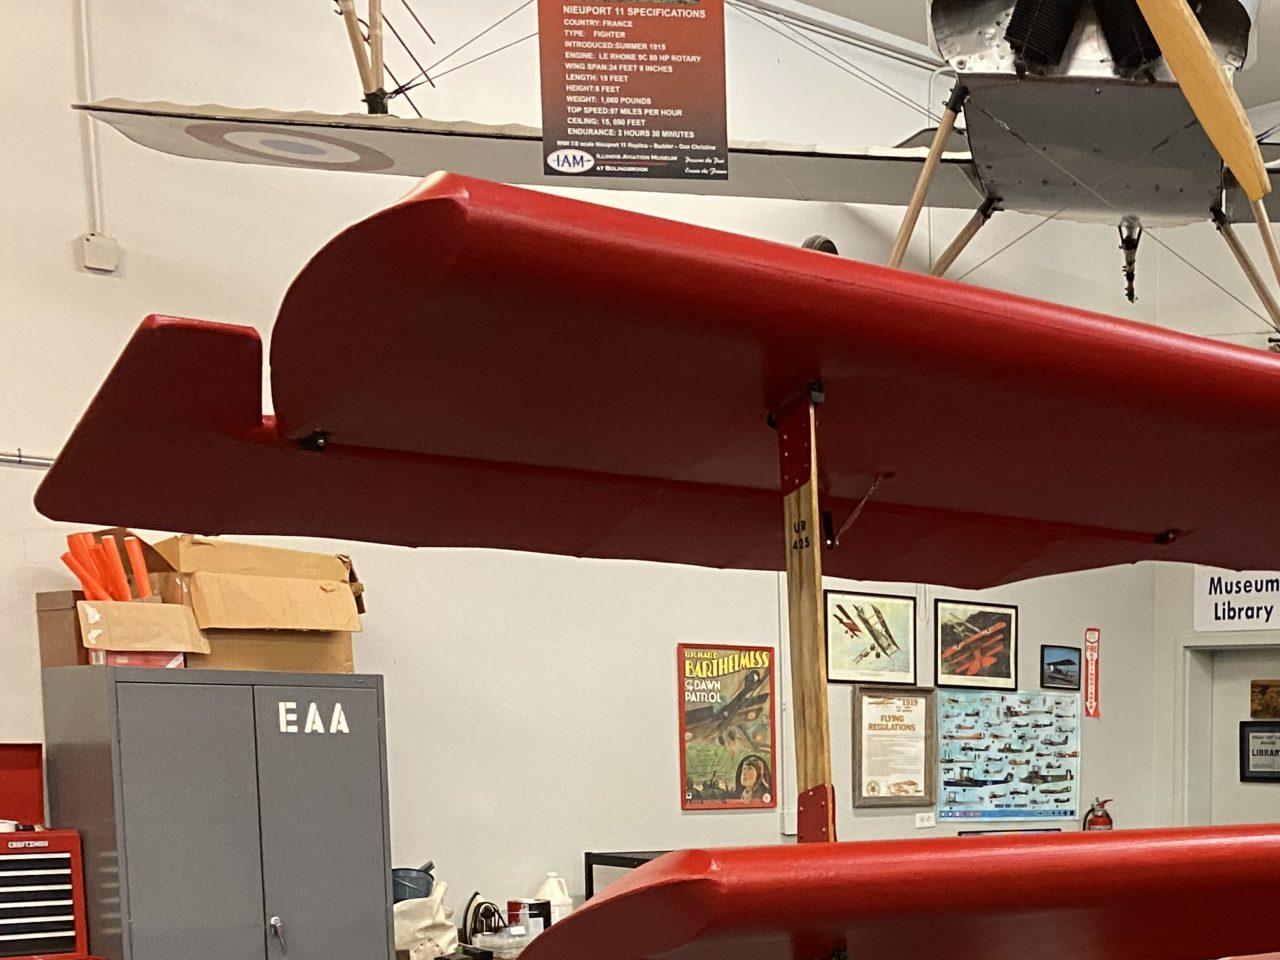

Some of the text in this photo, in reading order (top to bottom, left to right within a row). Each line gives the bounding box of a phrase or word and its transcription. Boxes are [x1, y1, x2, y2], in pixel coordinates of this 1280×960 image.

[563, 6, 705, 18] NIEUPORT 11 SPECIFICATIONS
[568, 128, 616, 136] ENDURANCE:
[557, 154, 584, 167] IAM
[793, 536, 810, 550] 425
[1208, 576, 1280, 596] Museum
[1214, 602, 1274, 623] Library
[685, 651, 769, 678] BARTHELMESS
[694, 680, 720, 690] DAWN
[685, 692, 721, 703] PATROL
[278, 702, 349, 734] EAA
